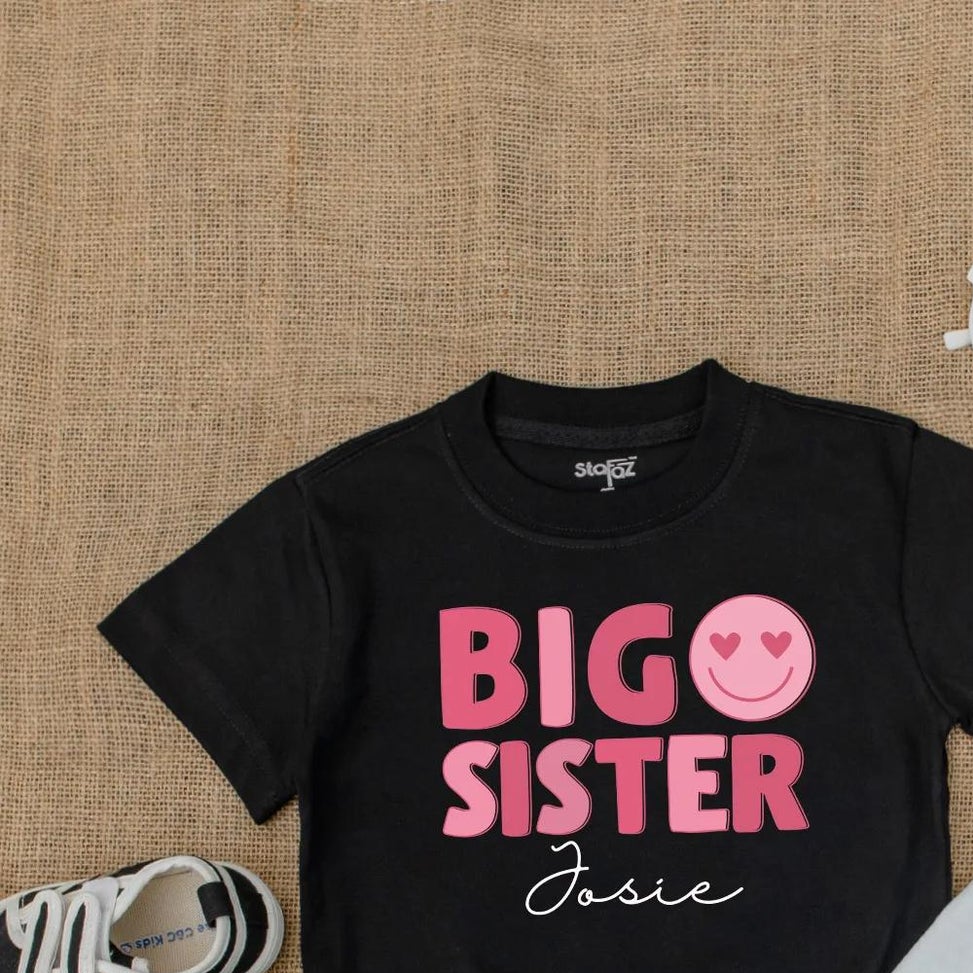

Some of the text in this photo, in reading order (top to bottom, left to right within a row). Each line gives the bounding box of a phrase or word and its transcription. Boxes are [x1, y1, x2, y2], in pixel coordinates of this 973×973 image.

[439, 602, 679, 731] BIG
[441, 733, 811, 839] SISTER
[525, 840, 745, 916] Josie
[134, 934, 164, 949] Kids
